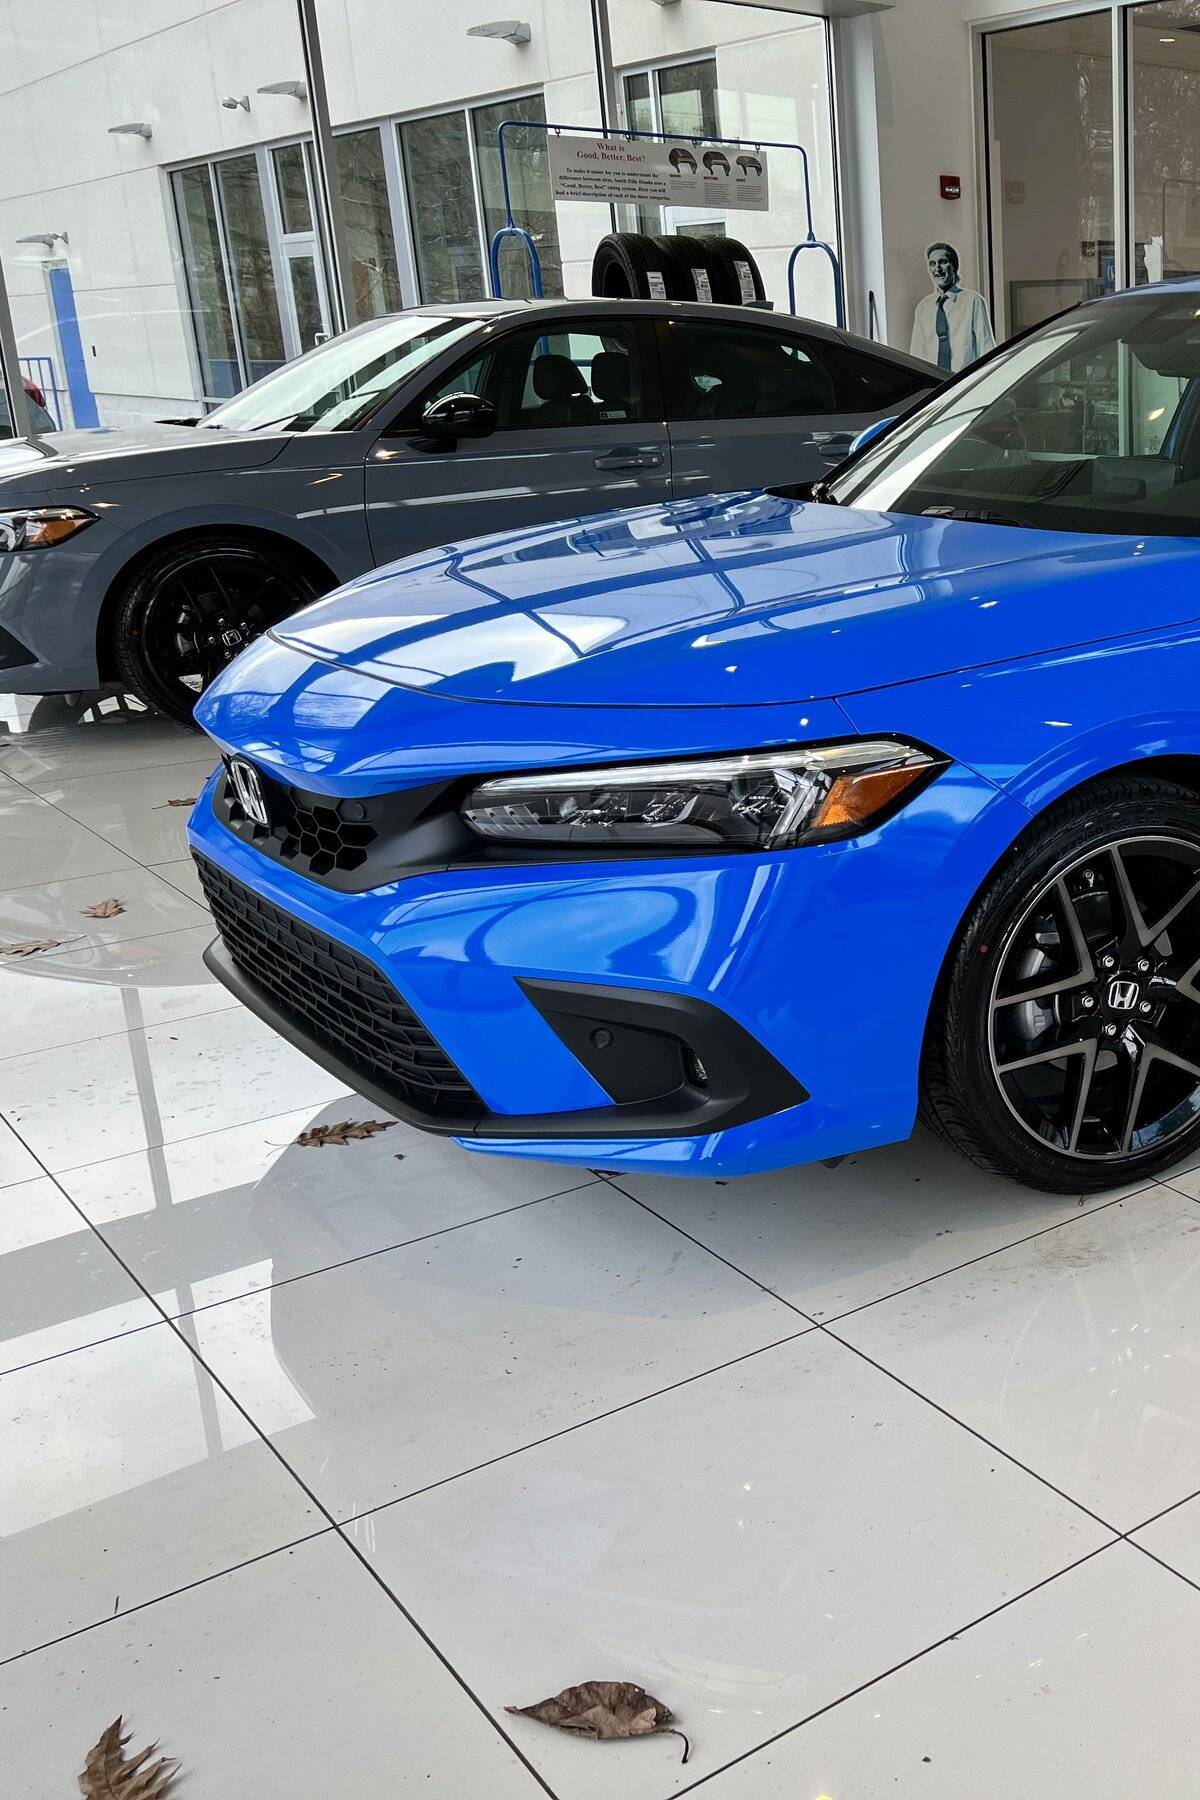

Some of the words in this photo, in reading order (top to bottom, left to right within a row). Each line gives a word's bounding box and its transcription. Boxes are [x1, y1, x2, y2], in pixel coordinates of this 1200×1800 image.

[597, 142, 617, 151] What
[577, 151, 599, 160] Good,
[602, 153, 625, 161] Better,
[626, 154, 645, 162] Best?
